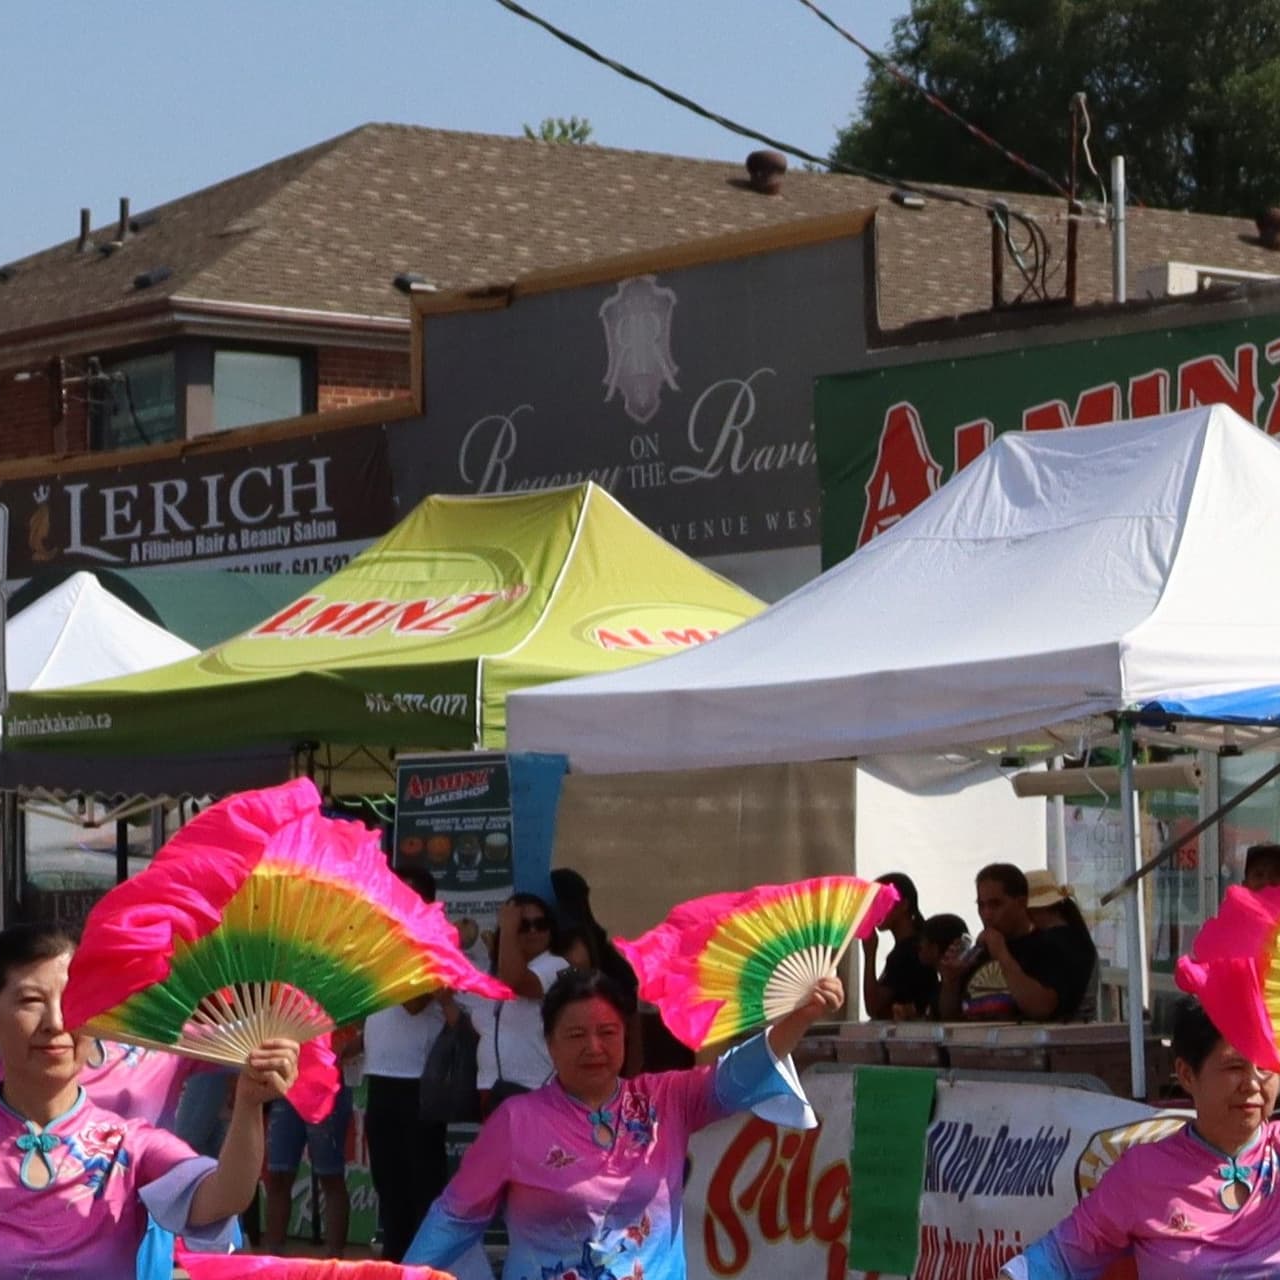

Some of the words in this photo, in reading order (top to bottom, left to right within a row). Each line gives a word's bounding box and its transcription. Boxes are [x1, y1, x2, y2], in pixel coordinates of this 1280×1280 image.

[630, 434, 660, 460] ON
[670, 367, 818, 484] Ravi
[626, 461, 667, 489] THE
[63, 456, 335, 563] LERICH
[657, 514, 751, 543] VENUE
[129, 542, 142, 563] A
[142, 538, 193, 563] Filipino
[195, 533, 225, 557] Hair
[227, 532, 239, 551] &
[240, 526, 292, 551] Beauty
[294, 518, 338, 544] Salon
[250, 590, 503, 641] LMINZ
[924, 1120, 960, 1193] All
[942, 1123, 992, 1203] Day
[973, 1124, 1072, 1197] Breakfast
